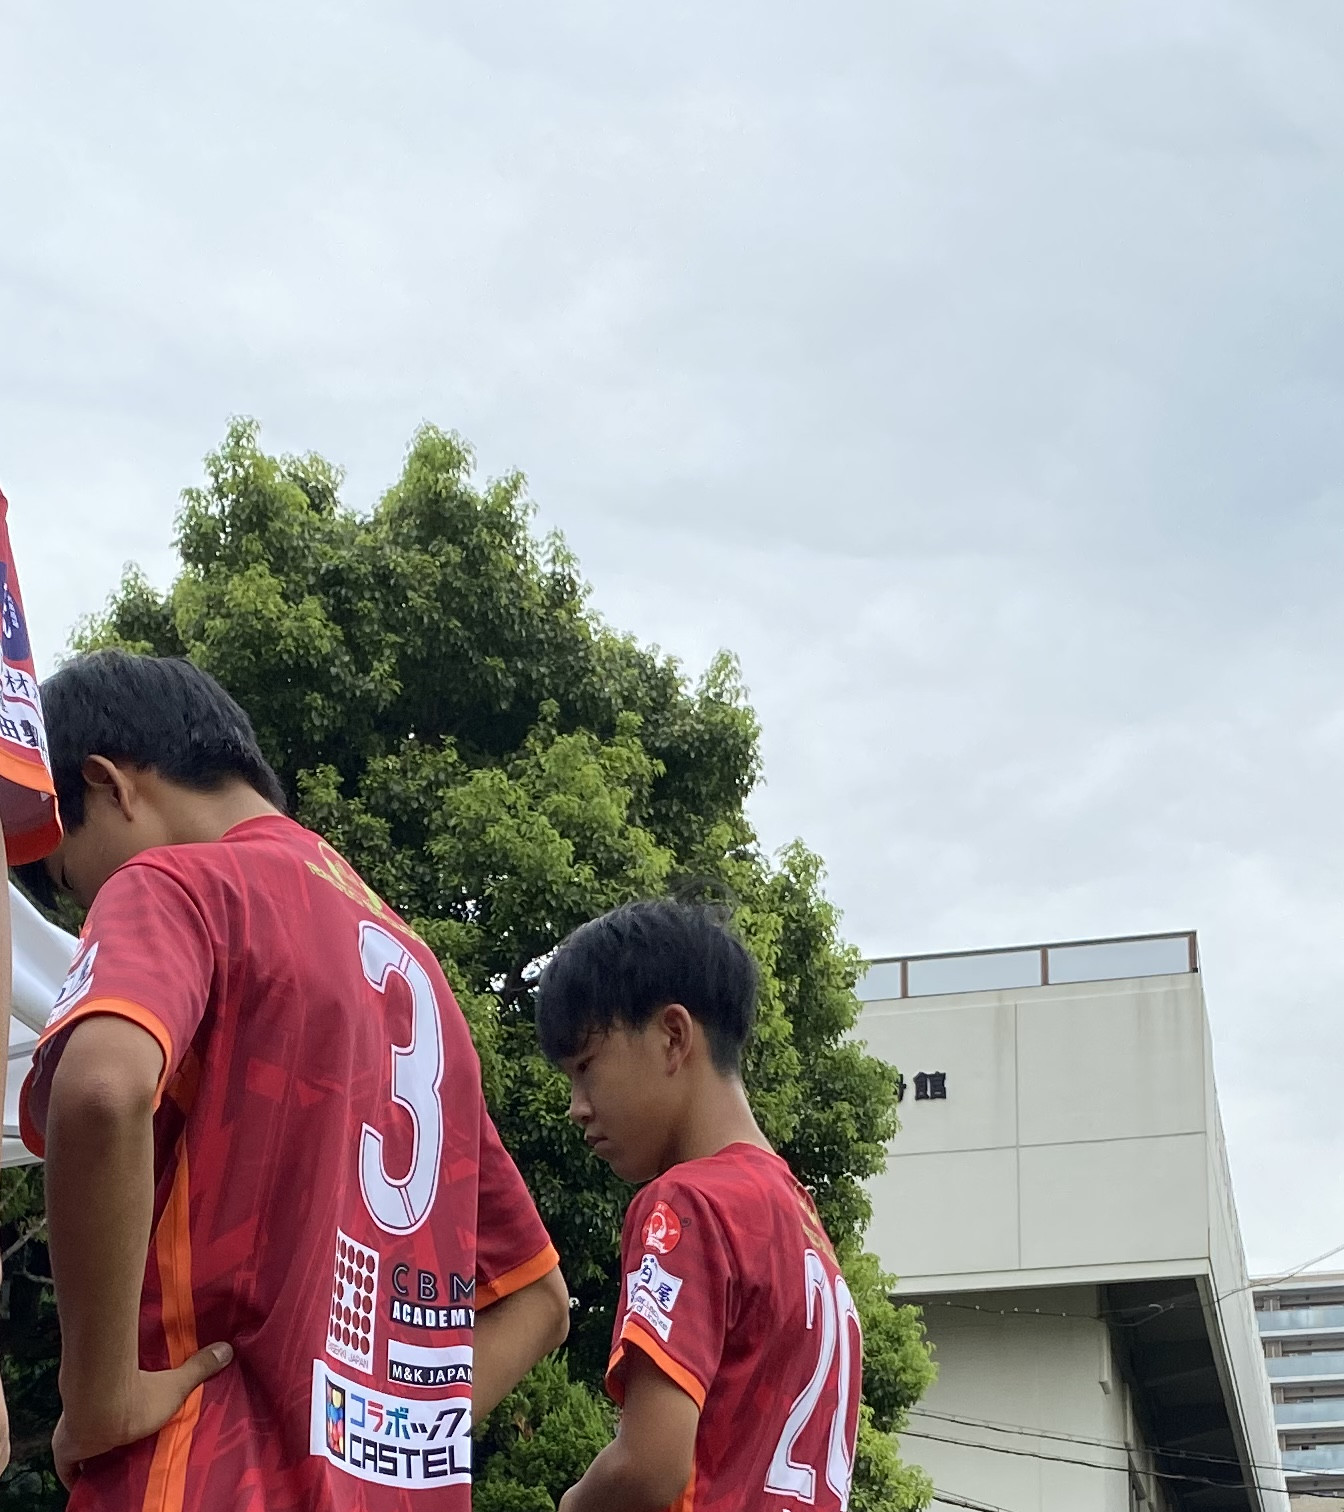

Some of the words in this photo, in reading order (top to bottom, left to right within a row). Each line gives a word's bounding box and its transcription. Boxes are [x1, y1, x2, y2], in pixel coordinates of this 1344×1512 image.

[358, 920, 444, 1236] 3
[392, 1364, 424, 1383] M&K
[349, 1394, 472, 1441] コラボック
[348, 1435, 472, 1479] CASTEL
